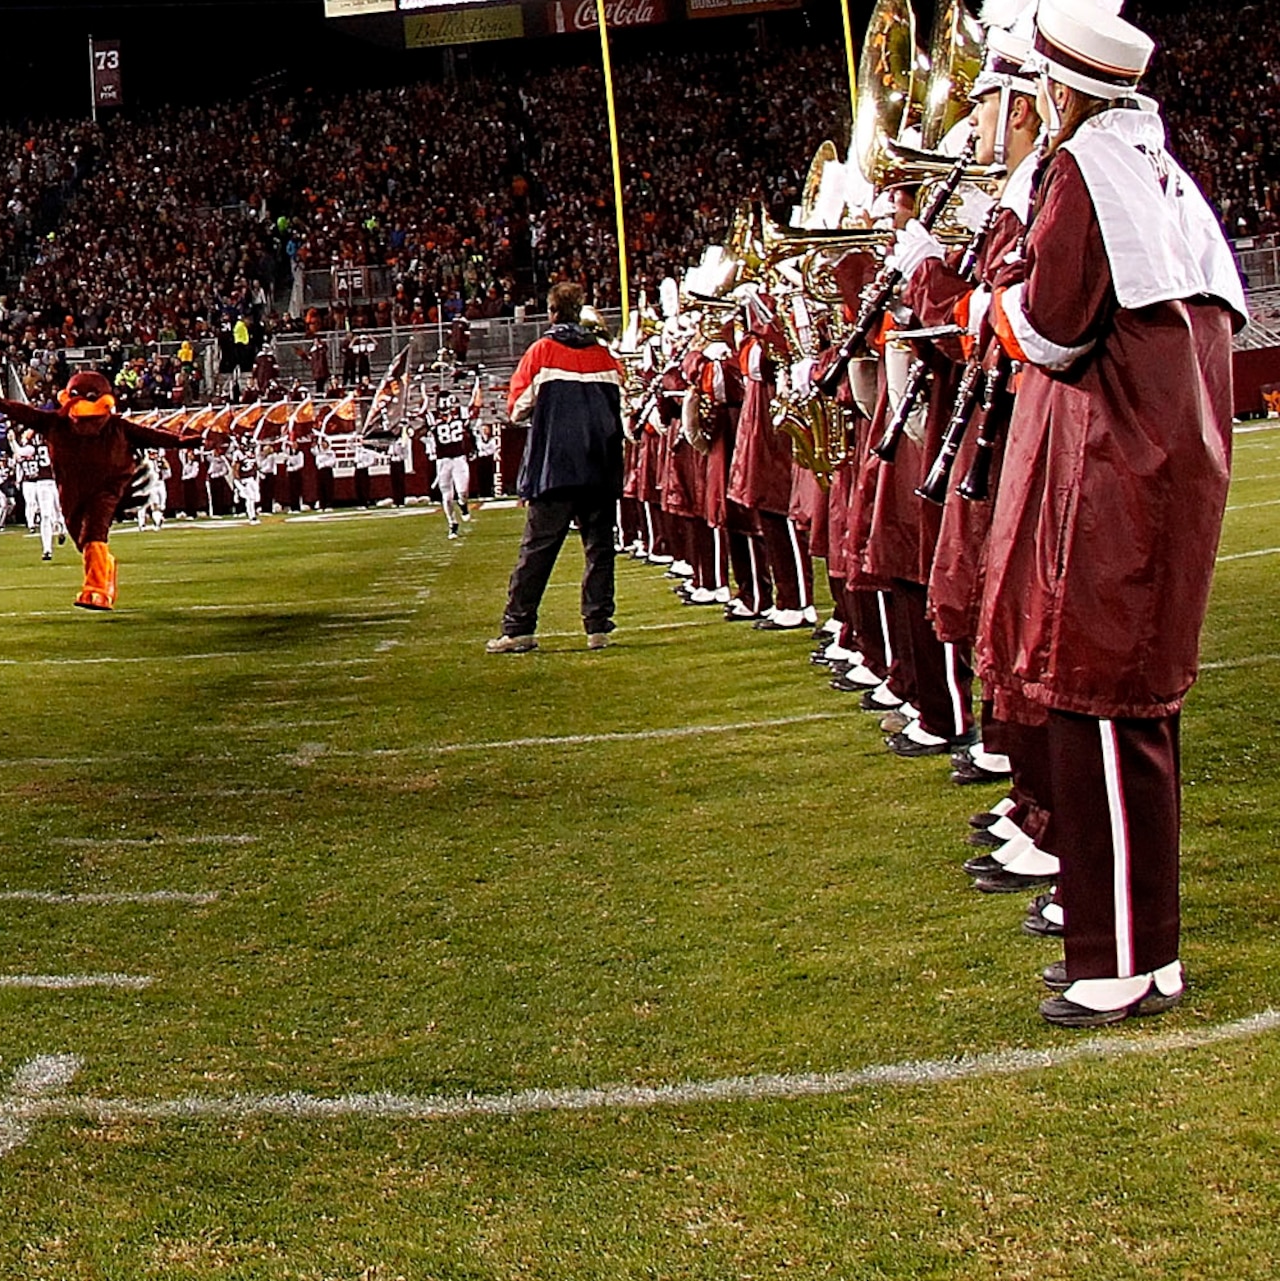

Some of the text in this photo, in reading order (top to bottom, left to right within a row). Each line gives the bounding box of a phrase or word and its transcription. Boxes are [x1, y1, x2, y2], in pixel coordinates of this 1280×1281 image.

[95, 50, 120, 70] 73
[437, 420, 463, 444] 82
[492, 423, 502, 497] HOKIES
